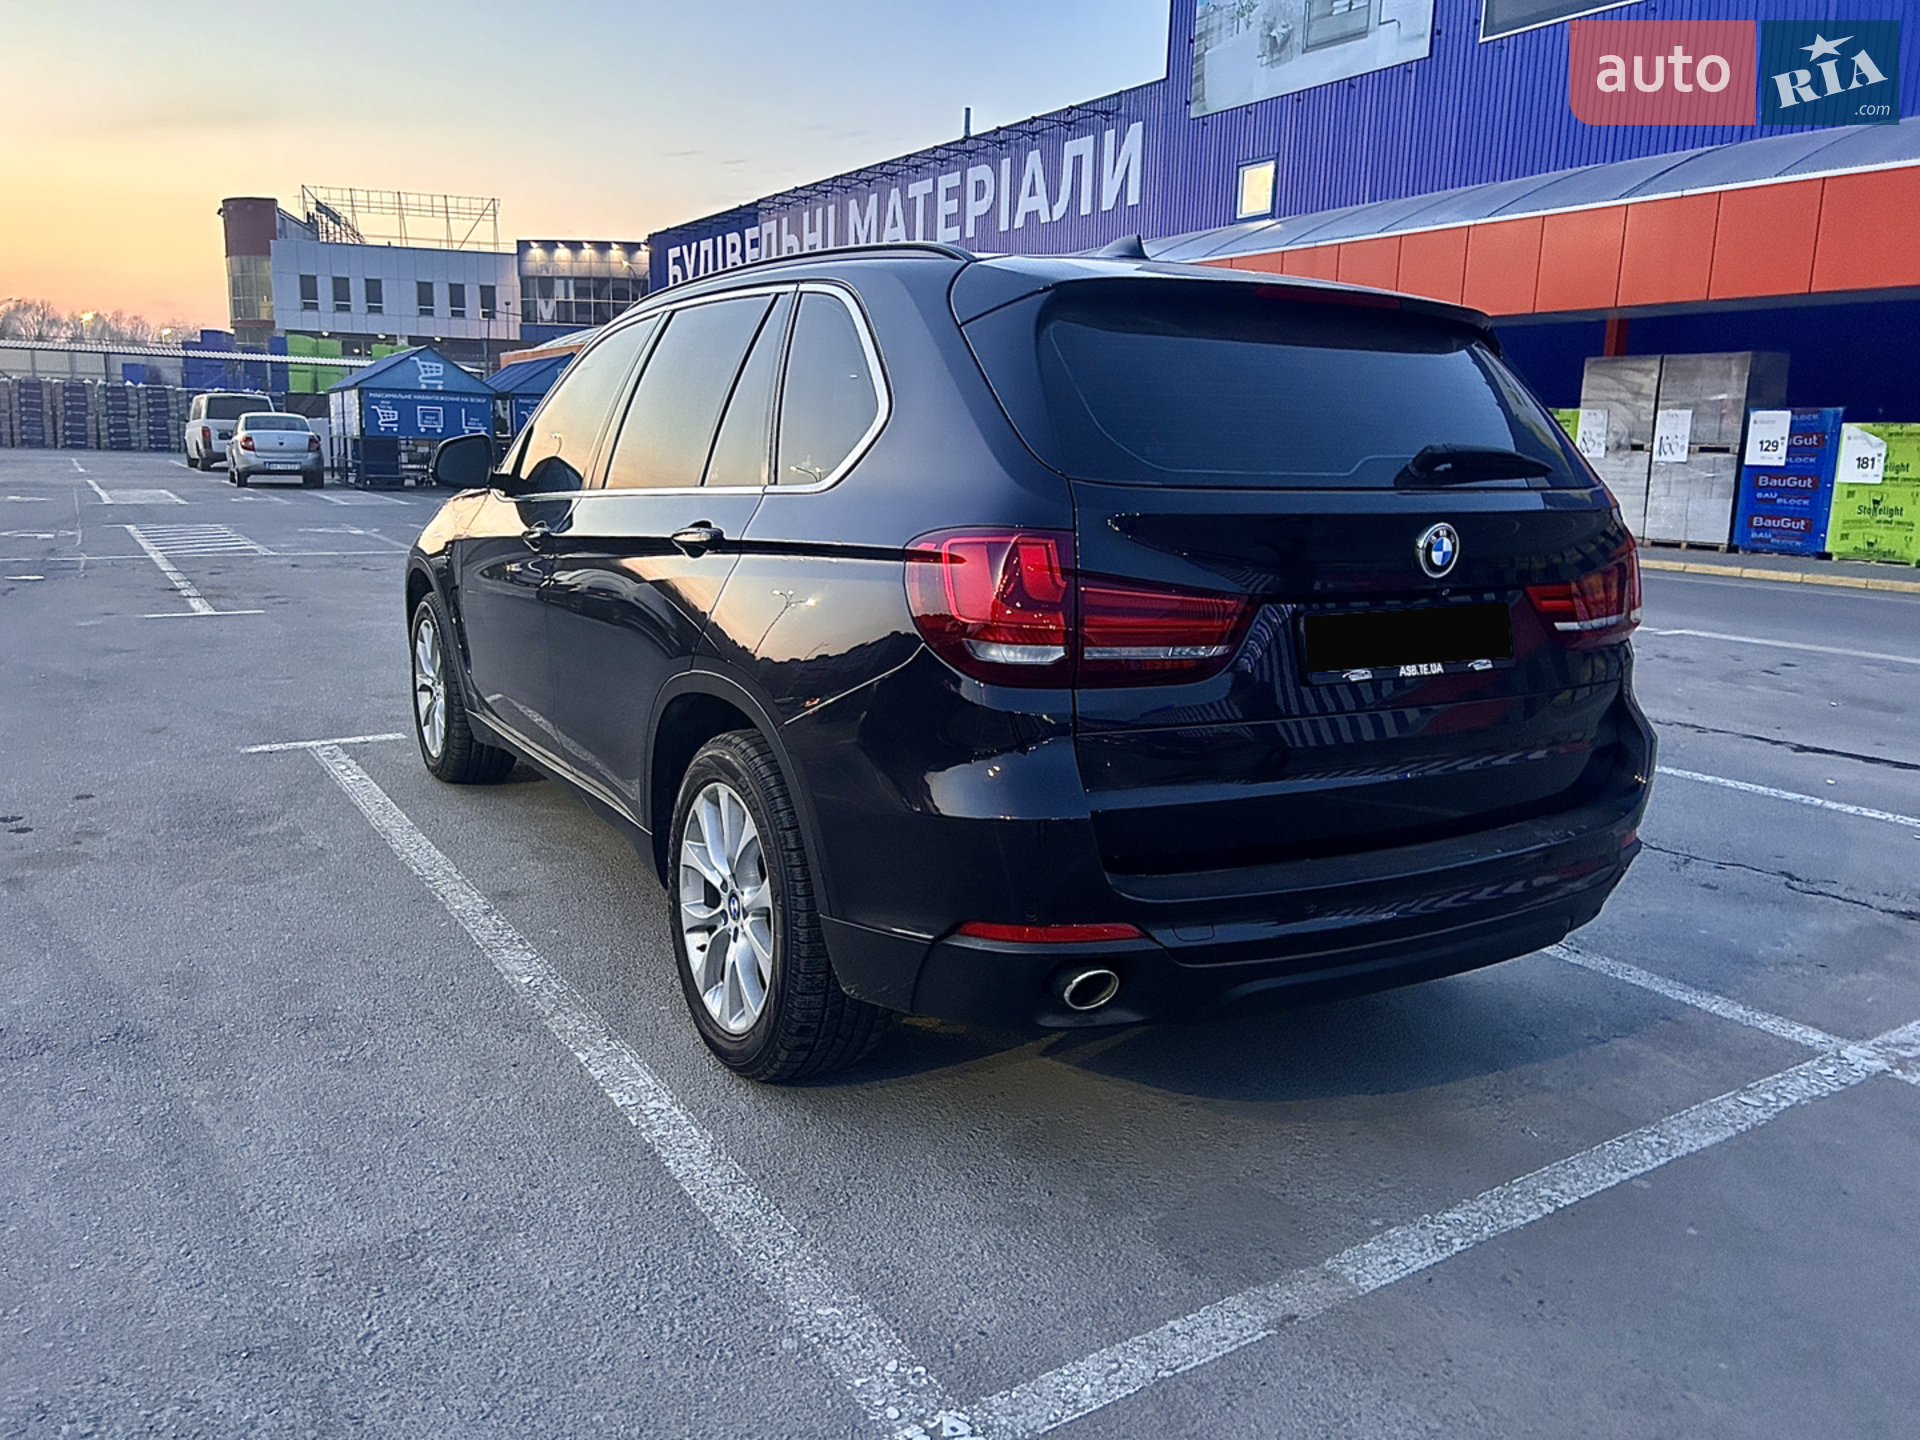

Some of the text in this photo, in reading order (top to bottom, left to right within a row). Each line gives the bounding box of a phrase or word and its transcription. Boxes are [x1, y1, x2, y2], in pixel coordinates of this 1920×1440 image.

[848, 121, 1144, 245] МАТЕРІАЛИ
[1758, 439, 1779, 452] 129
[1855, 456, 1876, 470] 181
[1758, 475, 1813, 488] BauGut
[1776, 498, 1811, 506] BLOCK
[1752, 516, 1806, 530] BauGut
[1398, 662, 1445, 677] ASB.TE.UA
